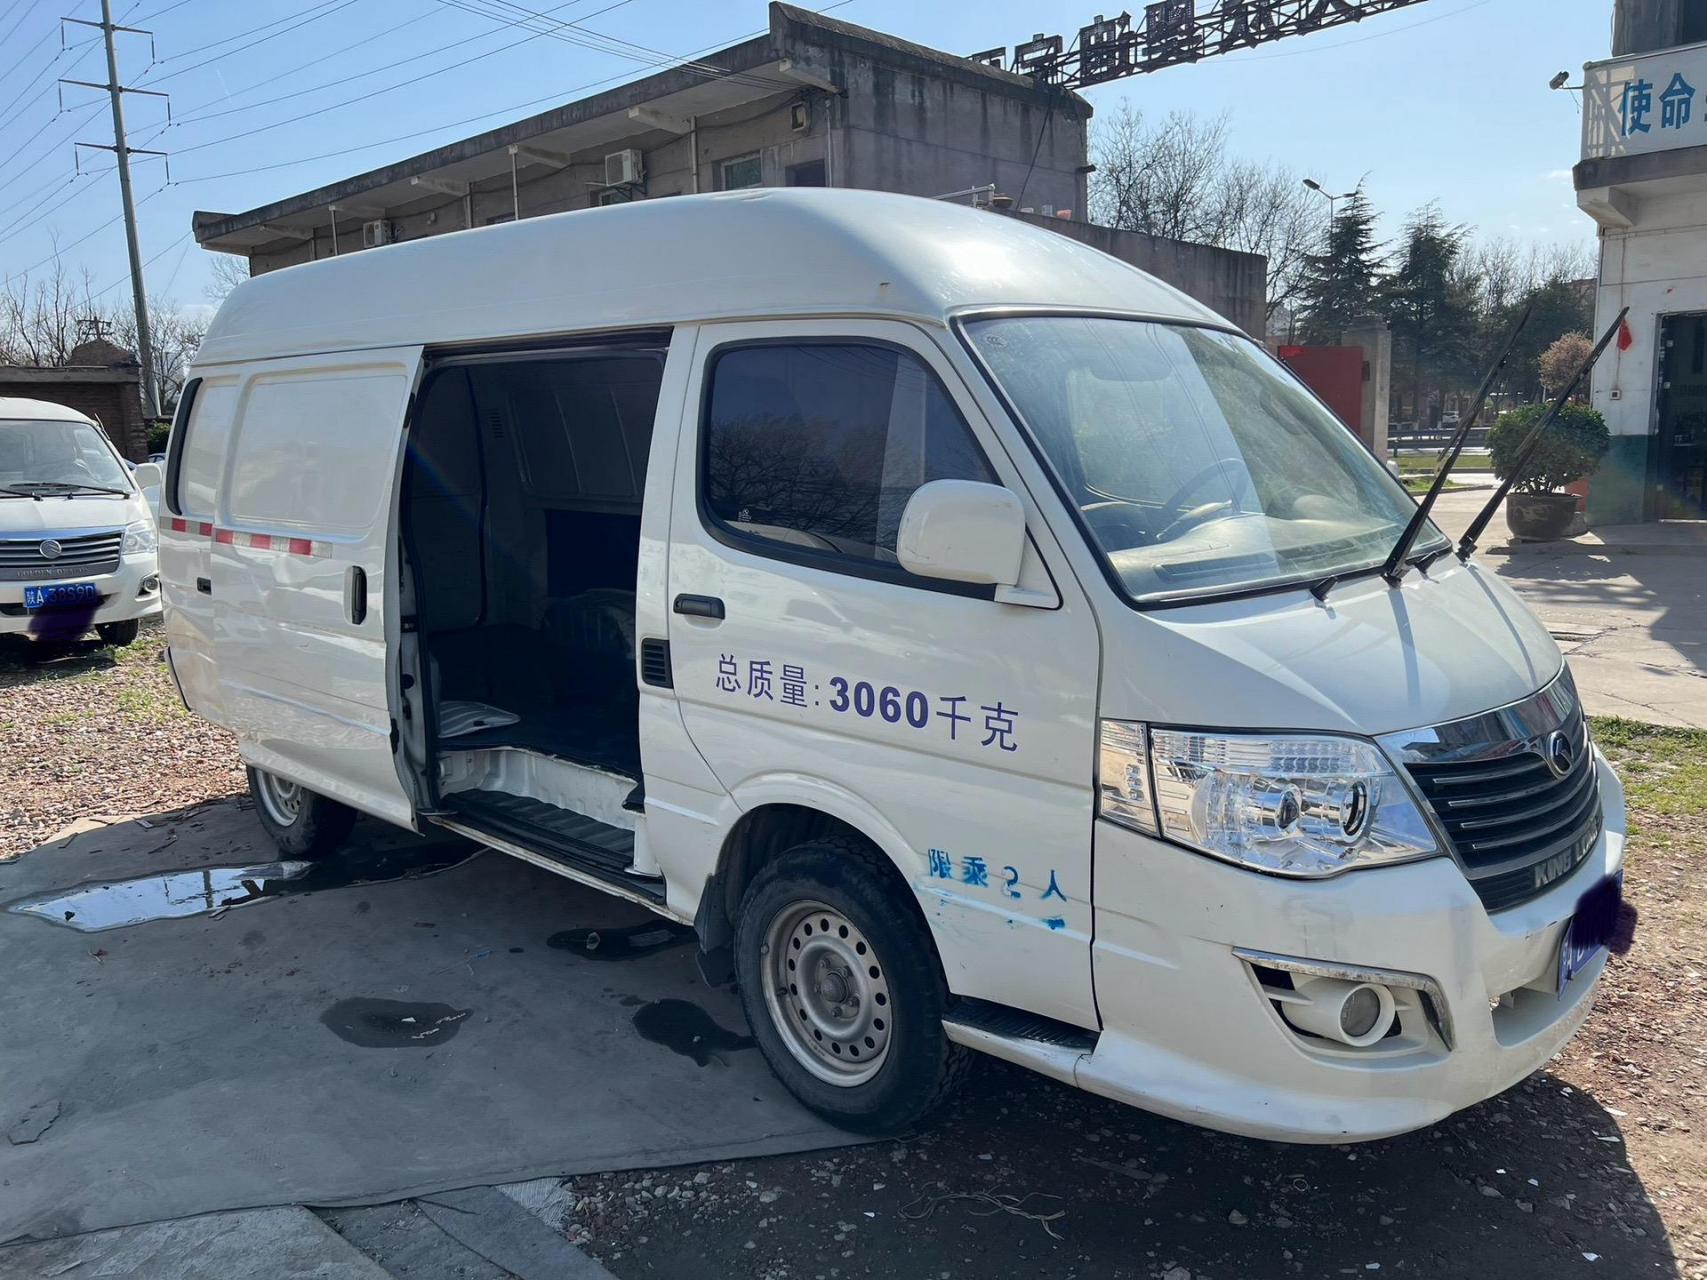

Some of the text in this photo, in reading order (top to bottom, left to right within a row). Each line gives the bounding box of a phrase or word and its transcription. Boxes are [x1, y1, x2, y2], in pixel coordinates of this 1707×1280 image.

[1618, 72, 1707, 137] 使命
[928, 849, 1067, 902] 限乘2人
[1535, 847, 1572, 888] KING
